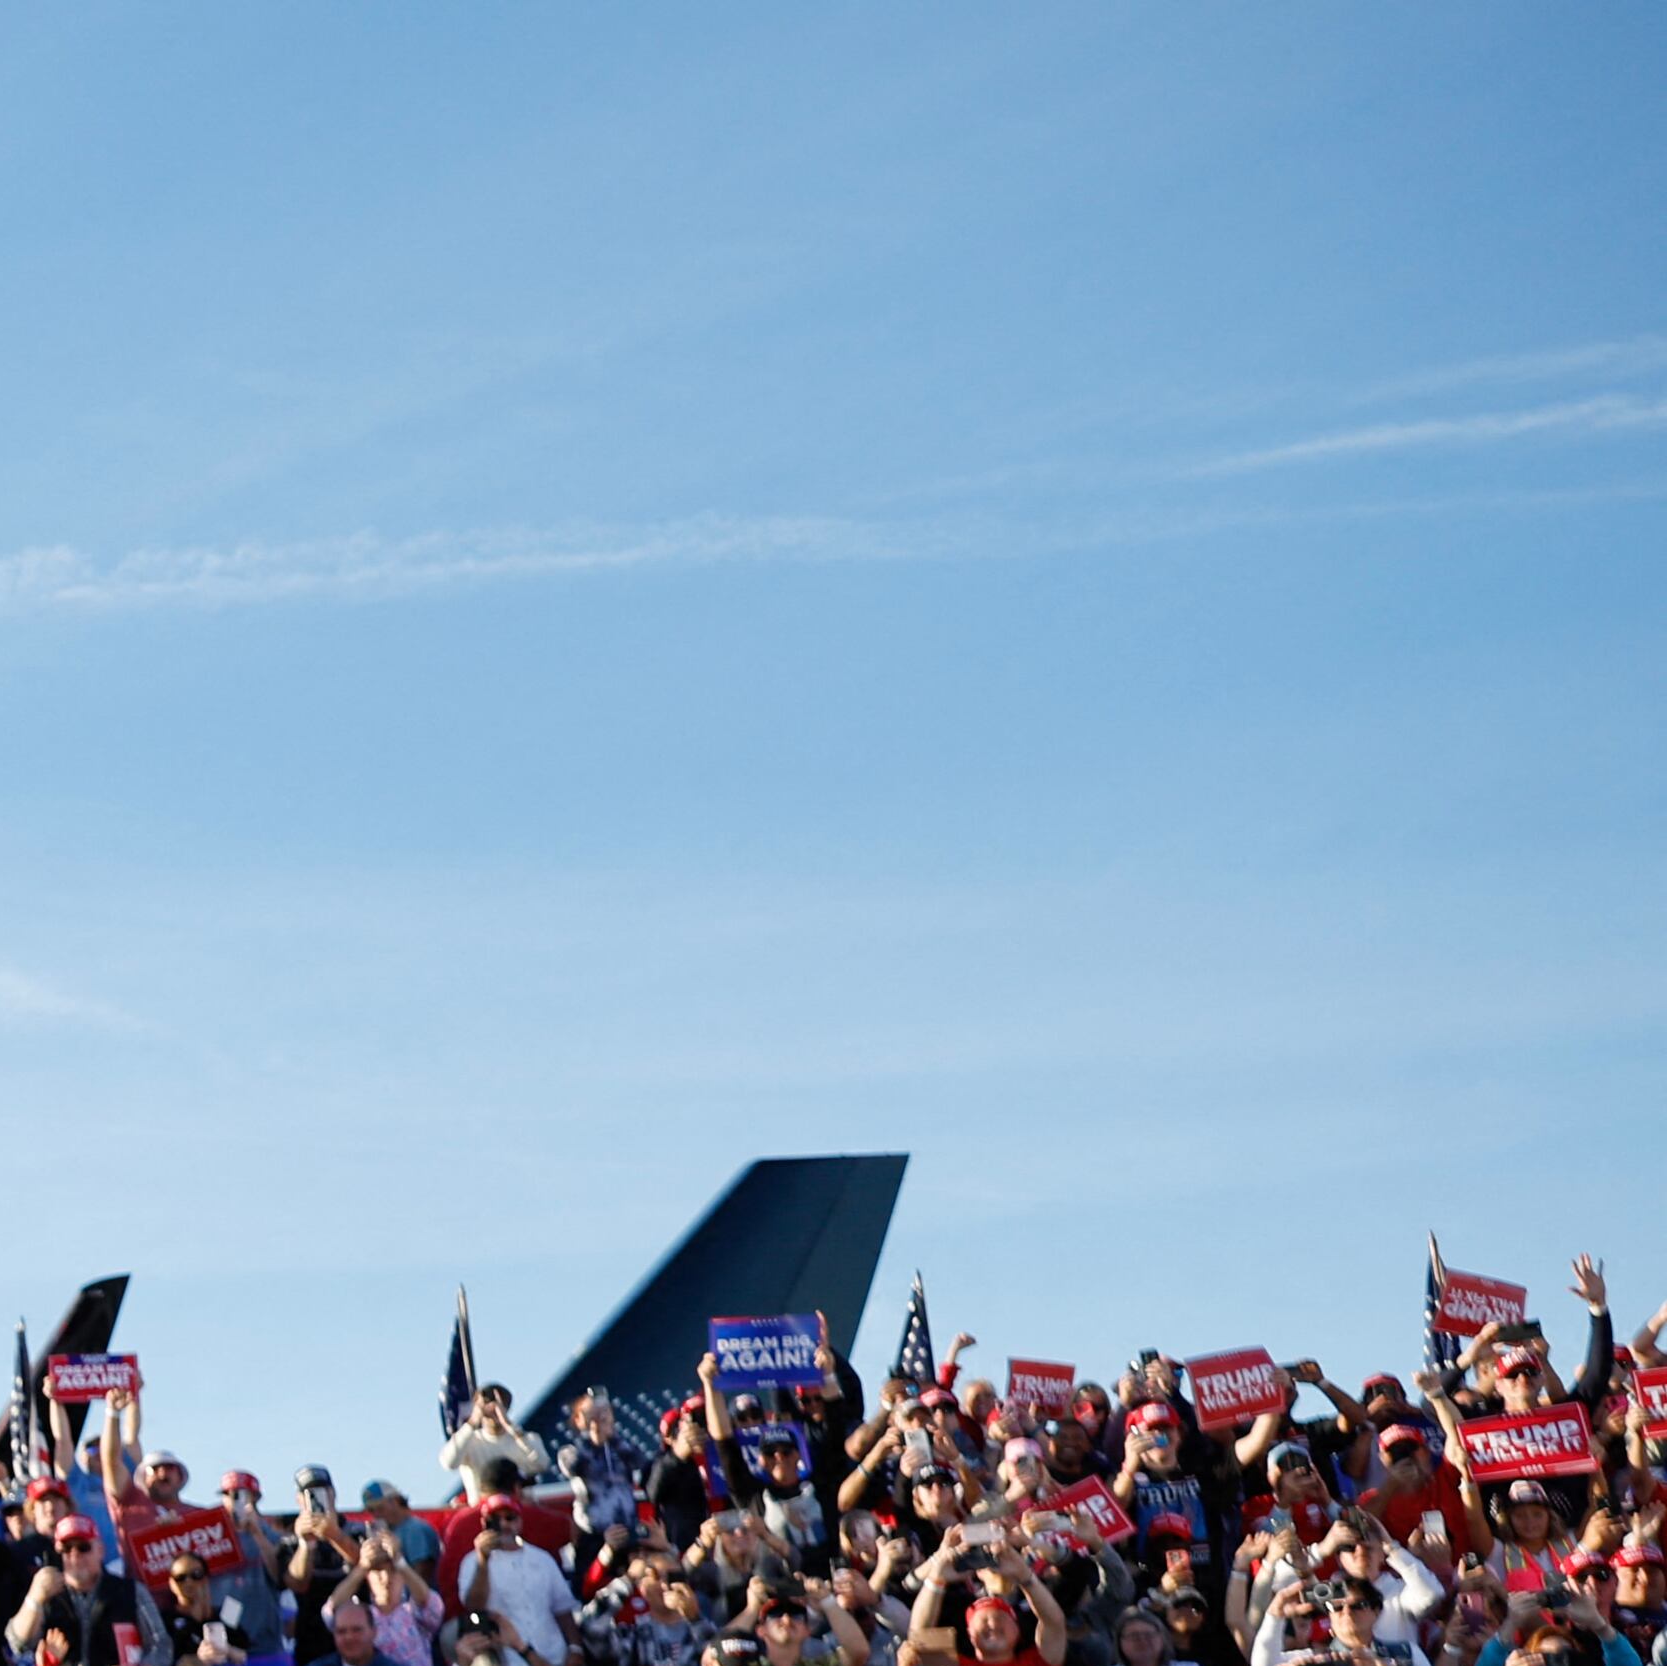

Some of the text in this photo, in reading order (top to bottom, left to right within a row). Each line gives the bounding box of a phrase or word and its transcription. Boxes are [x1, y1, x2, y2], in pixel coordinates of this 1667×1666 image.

[716, 1333, 816, 1353] DREAM BIG,
[54, 1364, 104, 1374] DREAM
[720, 1347, 809, 1372] AGAIN!
[57, 1371, 130, 1389] AGAIN!
[1011, 1374, 1069, 1394] TRUMP
[1195, 1363, 1272, 1396] TRUMP
[1201, 1391, 1239, 1412] WILL
[1466, 1419, 1580, 1453] TRUMP
[1471, 1434, 1583, 1466] WILL FIX IT
[144, 1523, 223, 1560] AGAIN!
